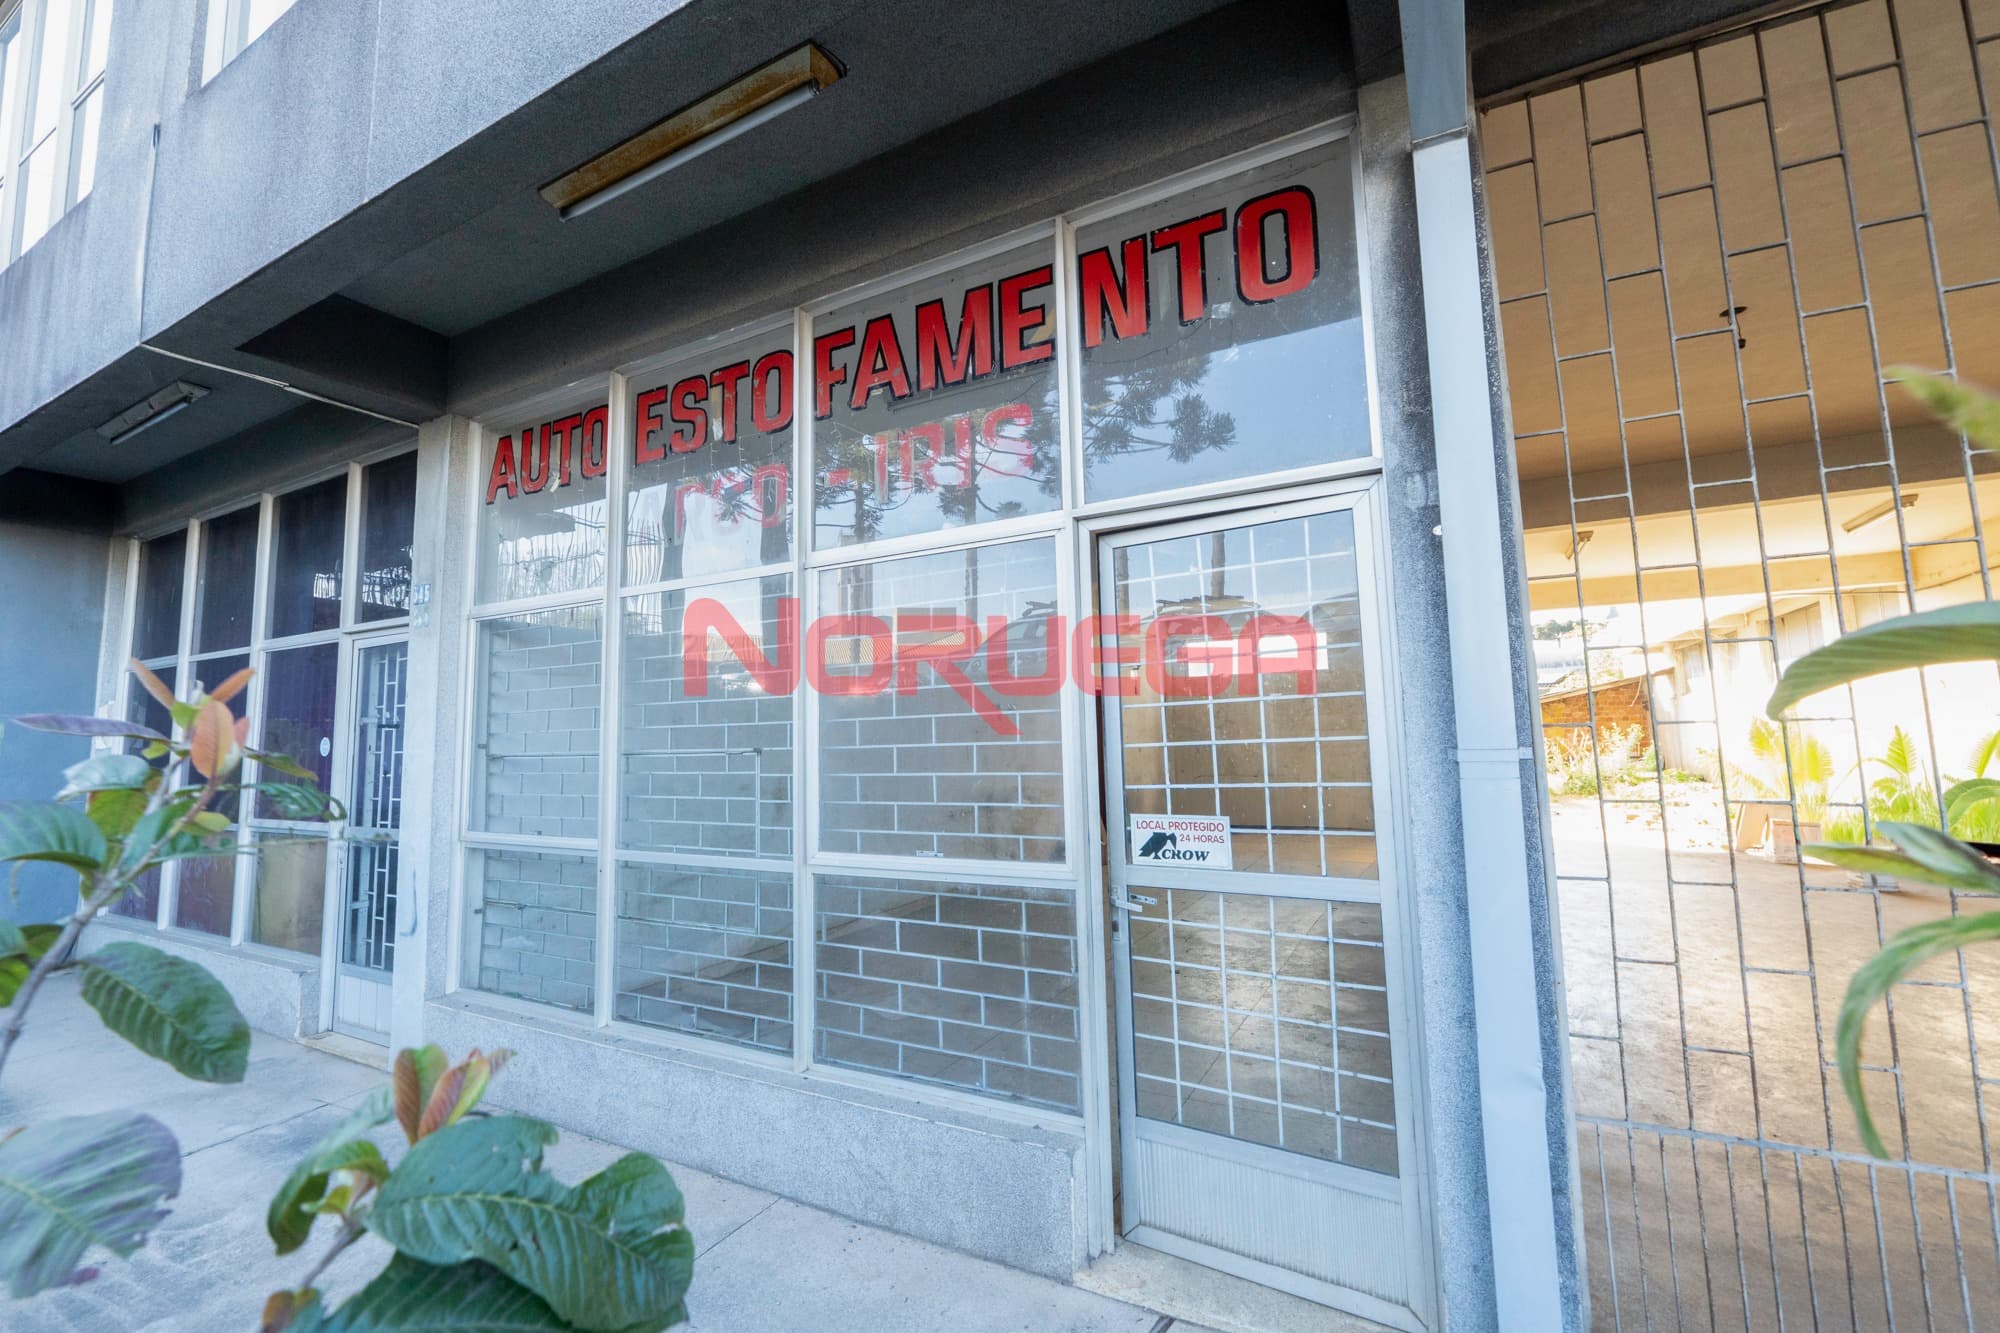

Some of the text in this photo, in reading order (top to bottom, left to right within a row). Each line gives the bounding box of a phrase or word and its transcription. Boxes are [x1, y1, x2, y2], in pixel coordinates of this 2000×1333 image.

[486, 404, 609, 504] AUTO
[1136, 820, 1225, 832] LOCAL PROTEGIDO
[1180, 834, 1225, 844] 24 HORAS
[1161, 849, 1210, 861] CROW
